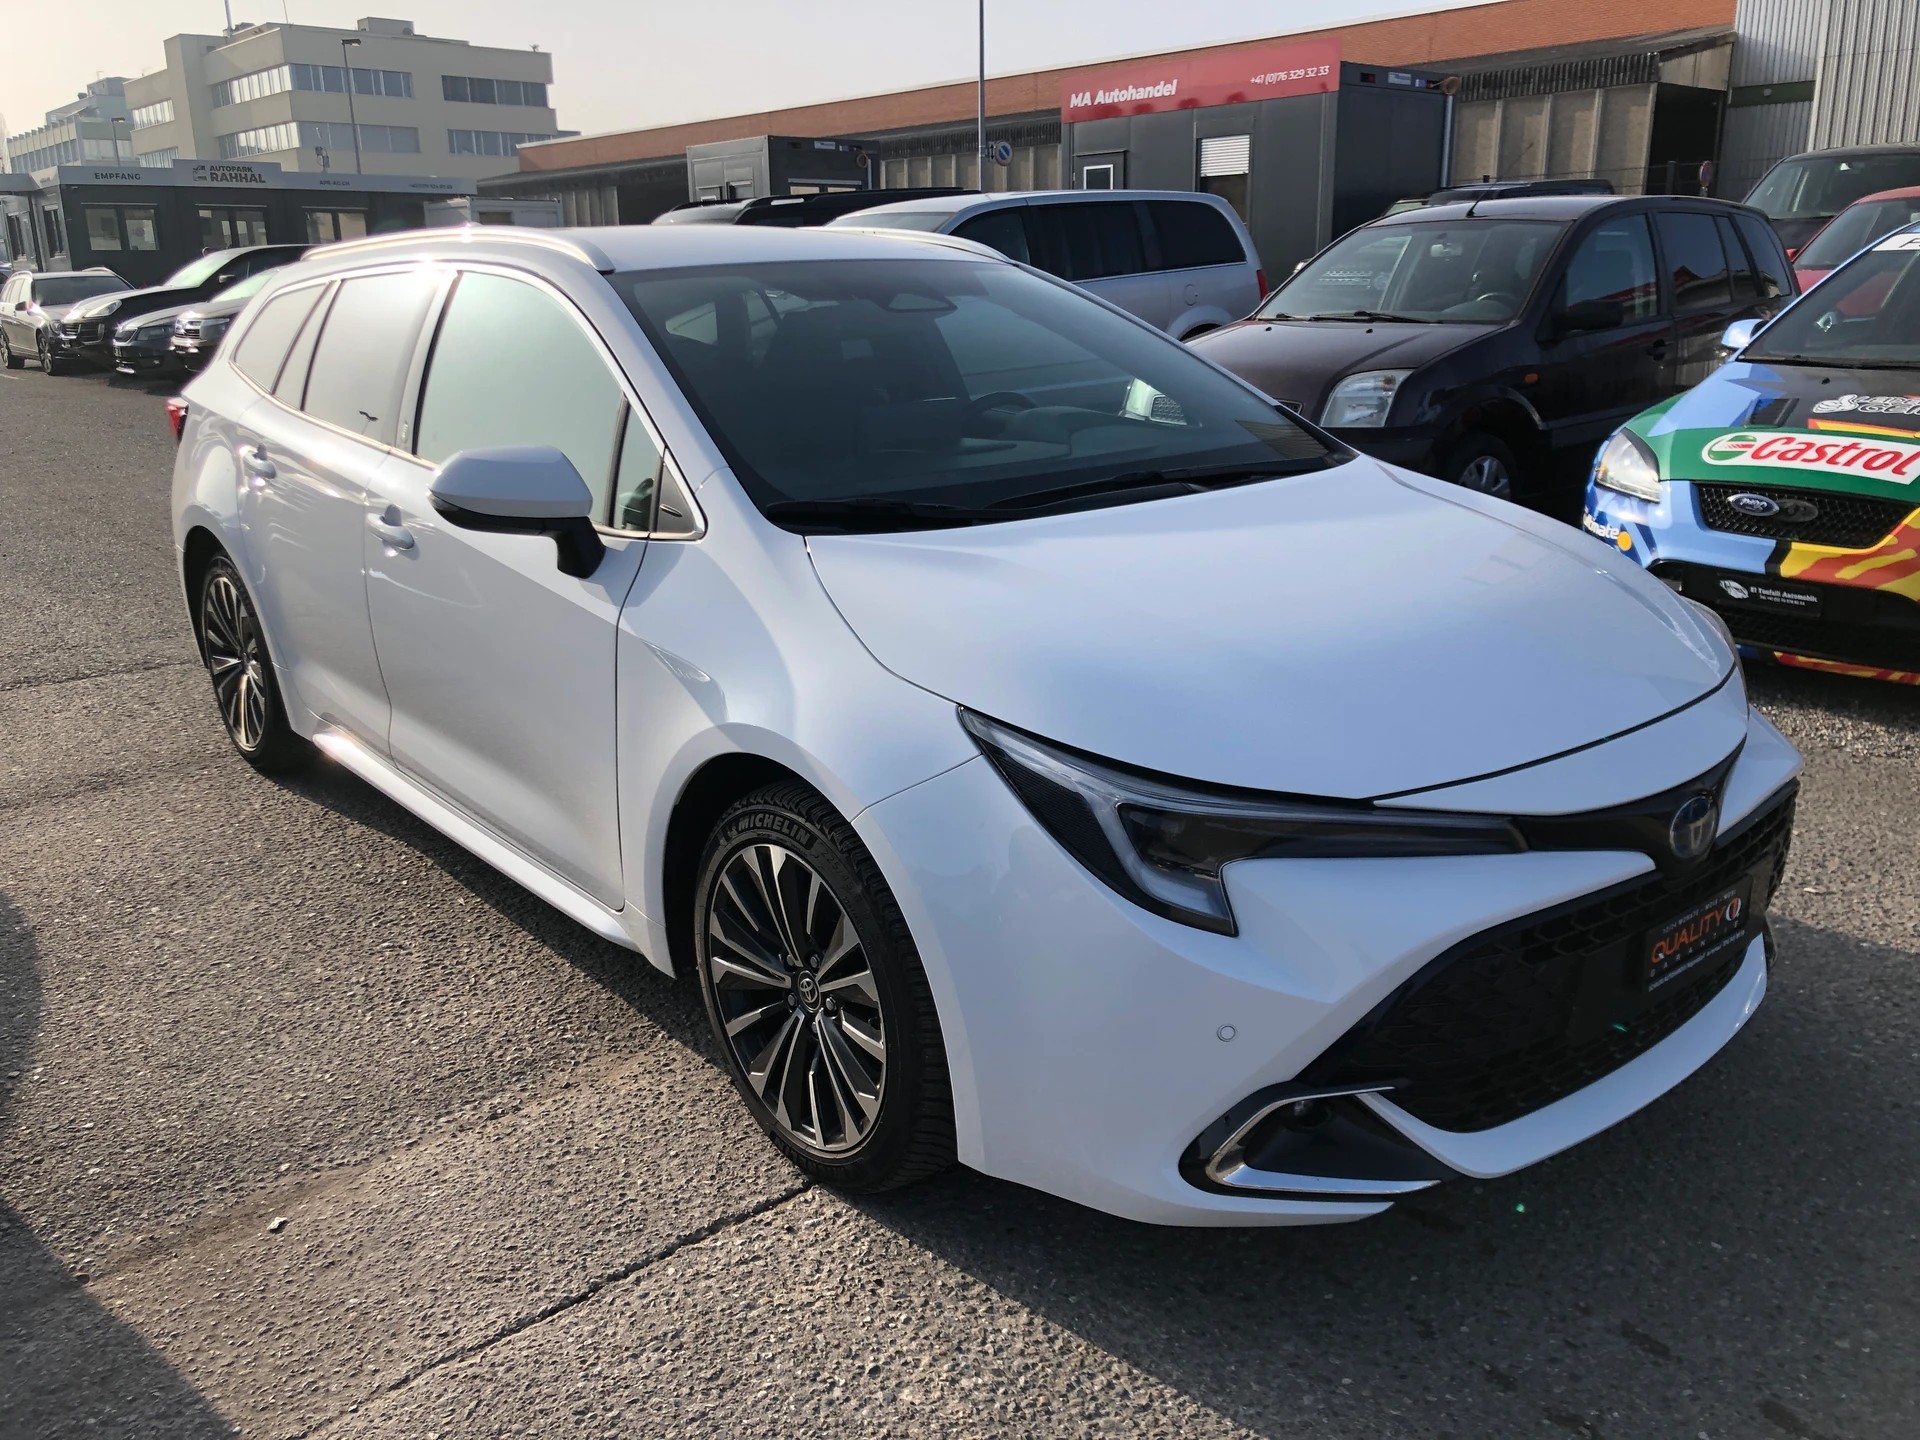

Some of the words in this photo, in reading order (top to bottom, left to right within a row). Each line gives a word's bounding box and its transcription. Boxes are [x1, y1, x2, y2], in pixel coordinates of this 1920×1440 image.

[1250, 74, 1264, 84] +41
[1265, 71, 1288, 85] (0)76
[1288, 69, 1305, 80] 329
[1305, 67, 1317, 78] 32
[1318, 65, 1330, 76] 33
[1070, 91, 1092, 108] MA
[1094, 79, 1178, 105] Autohandel
[94, 172, 141, 181] EMPFANG
[209, 165, 253, 173] AUTOPARK
[210, 172, 266, 184] RAHHAL
[1751, 436, 1920, 476] Castrol
[738, 813, 811, 845] MICHELIN
